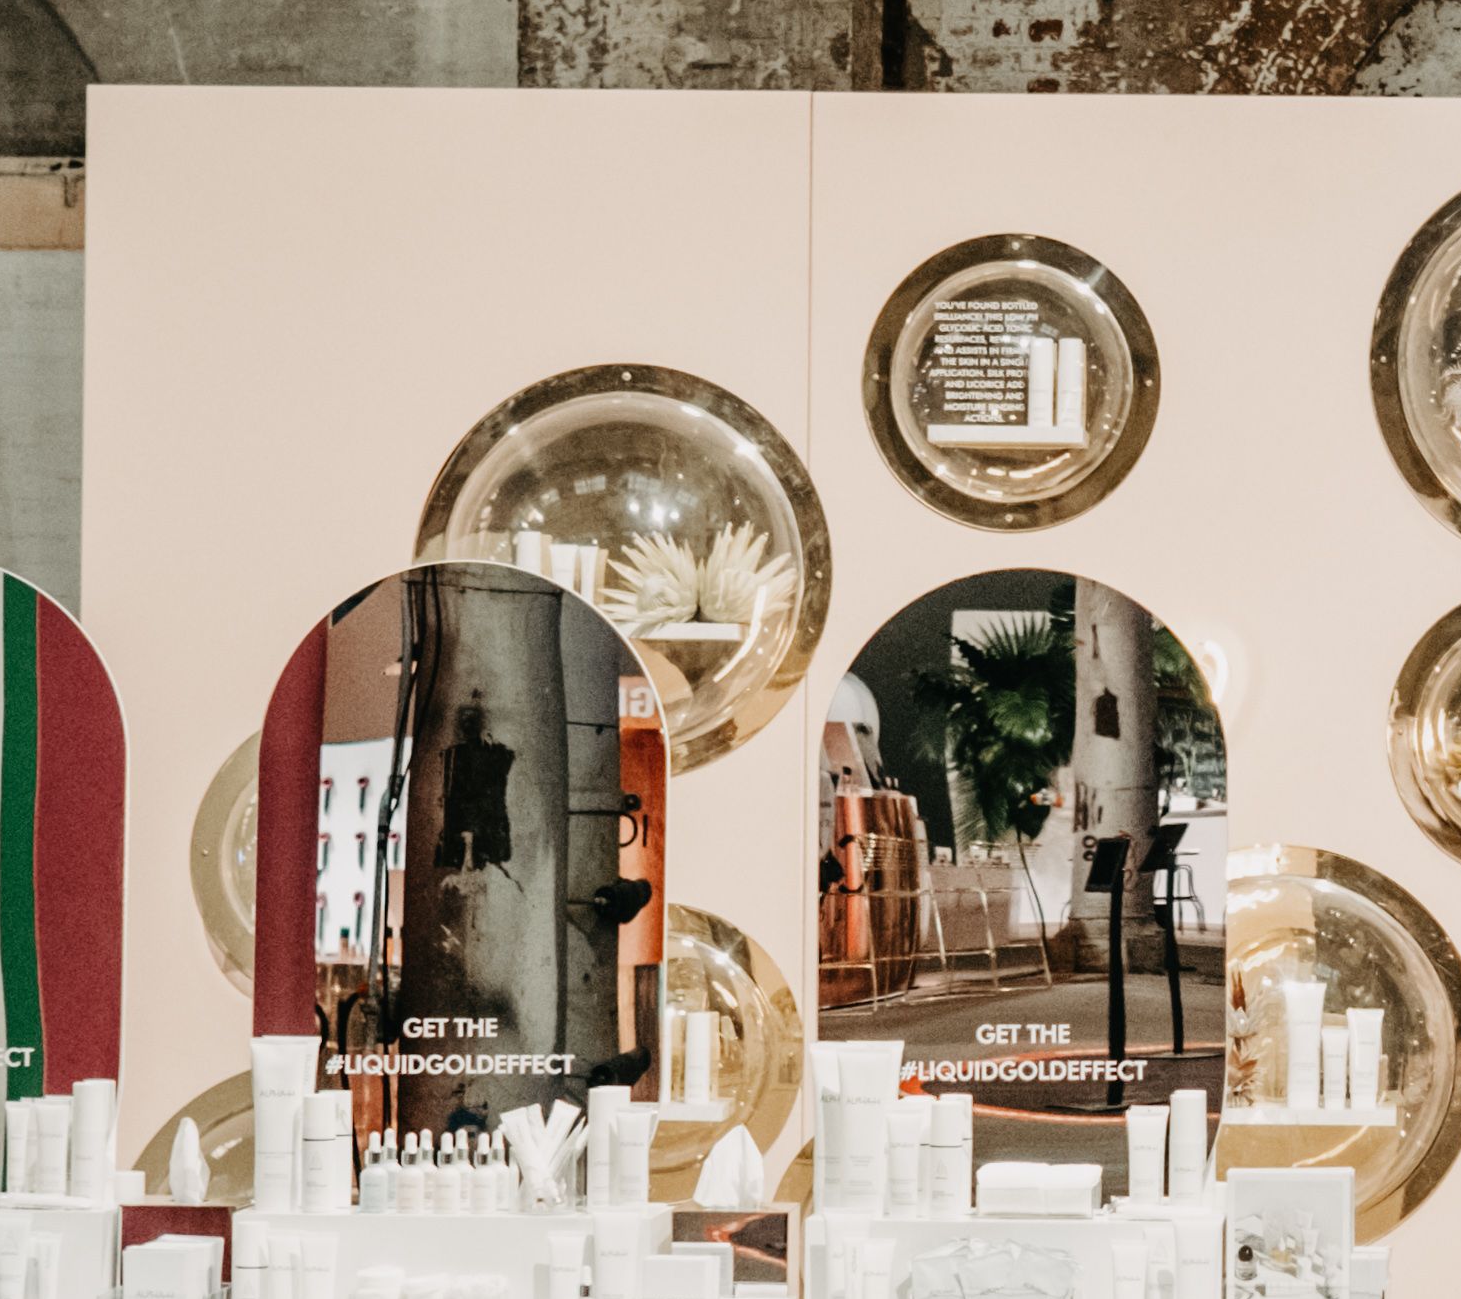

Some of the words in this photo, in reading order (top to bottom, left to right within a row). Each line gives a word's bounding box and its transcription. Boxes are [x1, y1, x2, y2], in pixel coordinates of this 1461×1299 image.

[967, 301, 1000, 311] FOUND
[944, 380, 965, 390] AND
[402, 1016, 449, 1040] GET
[452, 1017, 498, 1039] THE
[975, 1022, 1022, 1046] GET
[1025, 1023, 1070, 1044] THE
[325, 1053, 575, 1076] #LIQUIDGOLDEFFECT
[900, 1059, 1148, 1082] #LIQUIDGOLDEFFECT
